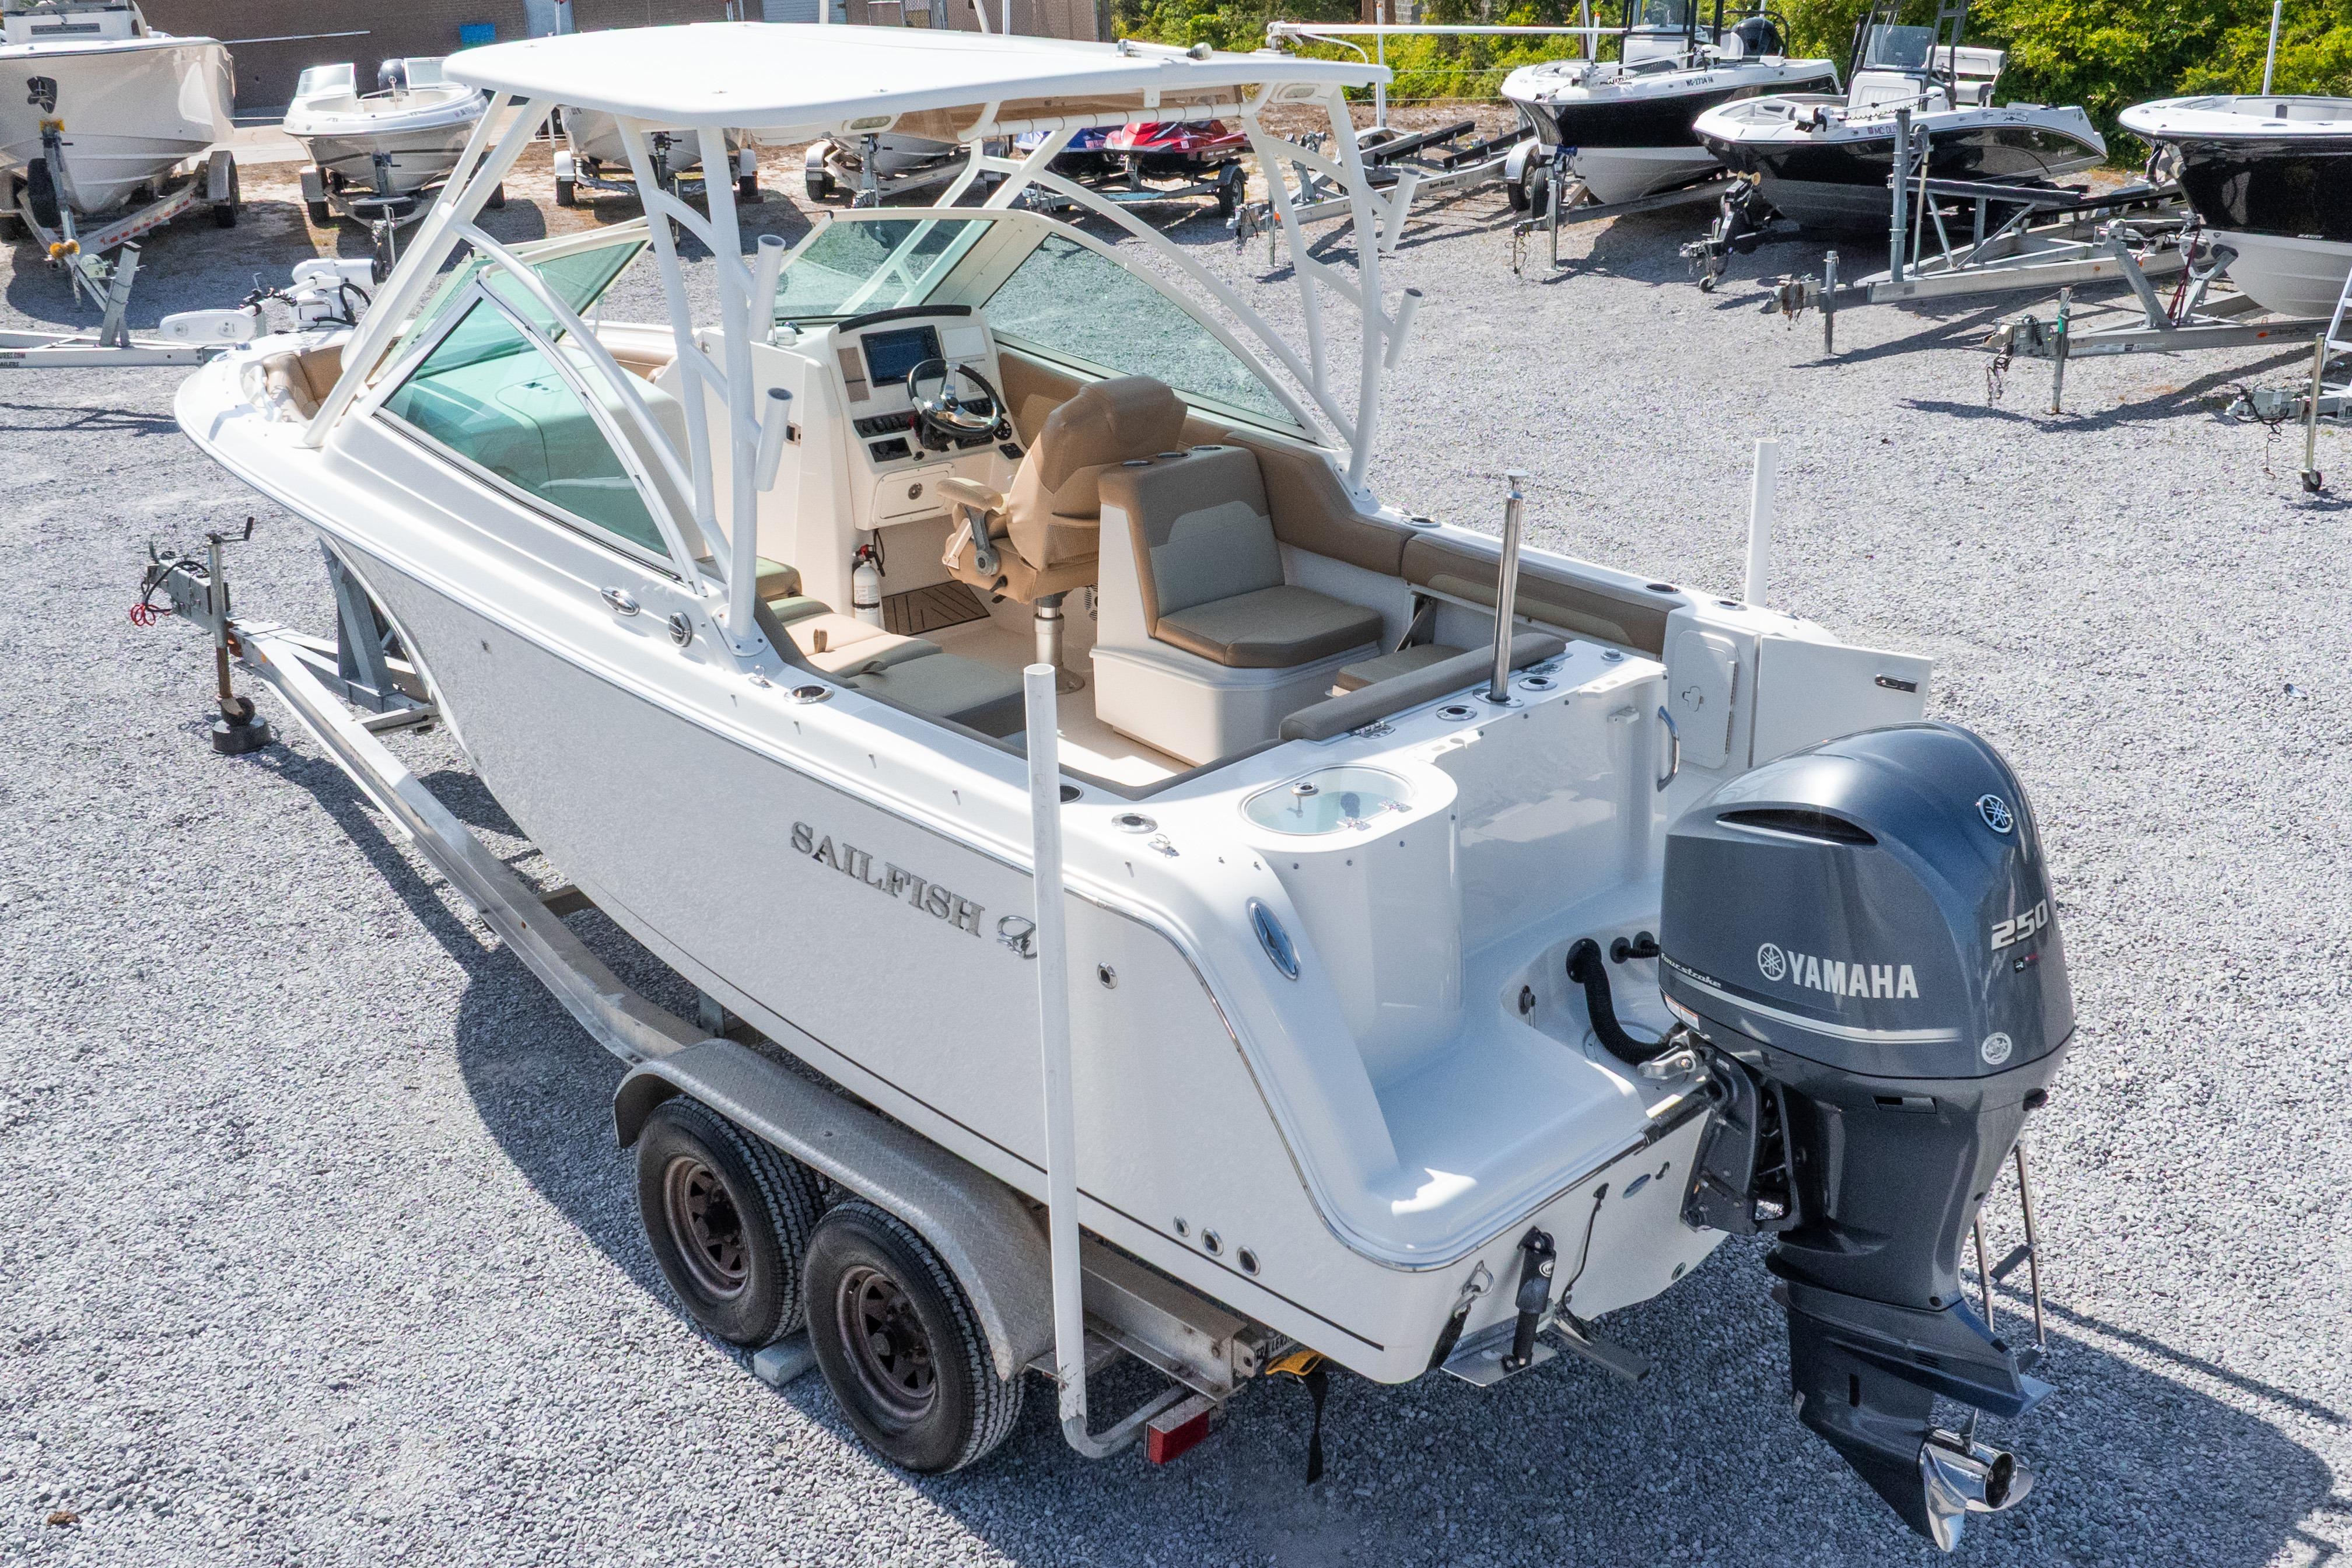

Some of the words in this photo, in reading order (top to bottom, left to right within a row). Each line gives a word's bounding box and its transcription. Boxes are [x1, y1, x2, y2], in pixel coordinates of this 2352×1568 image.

[791, 821, 986, 939] SAILFISH
[1991, 899, 2048, 950] 250
[1787, 950, 1919, 998] YAMAHA
